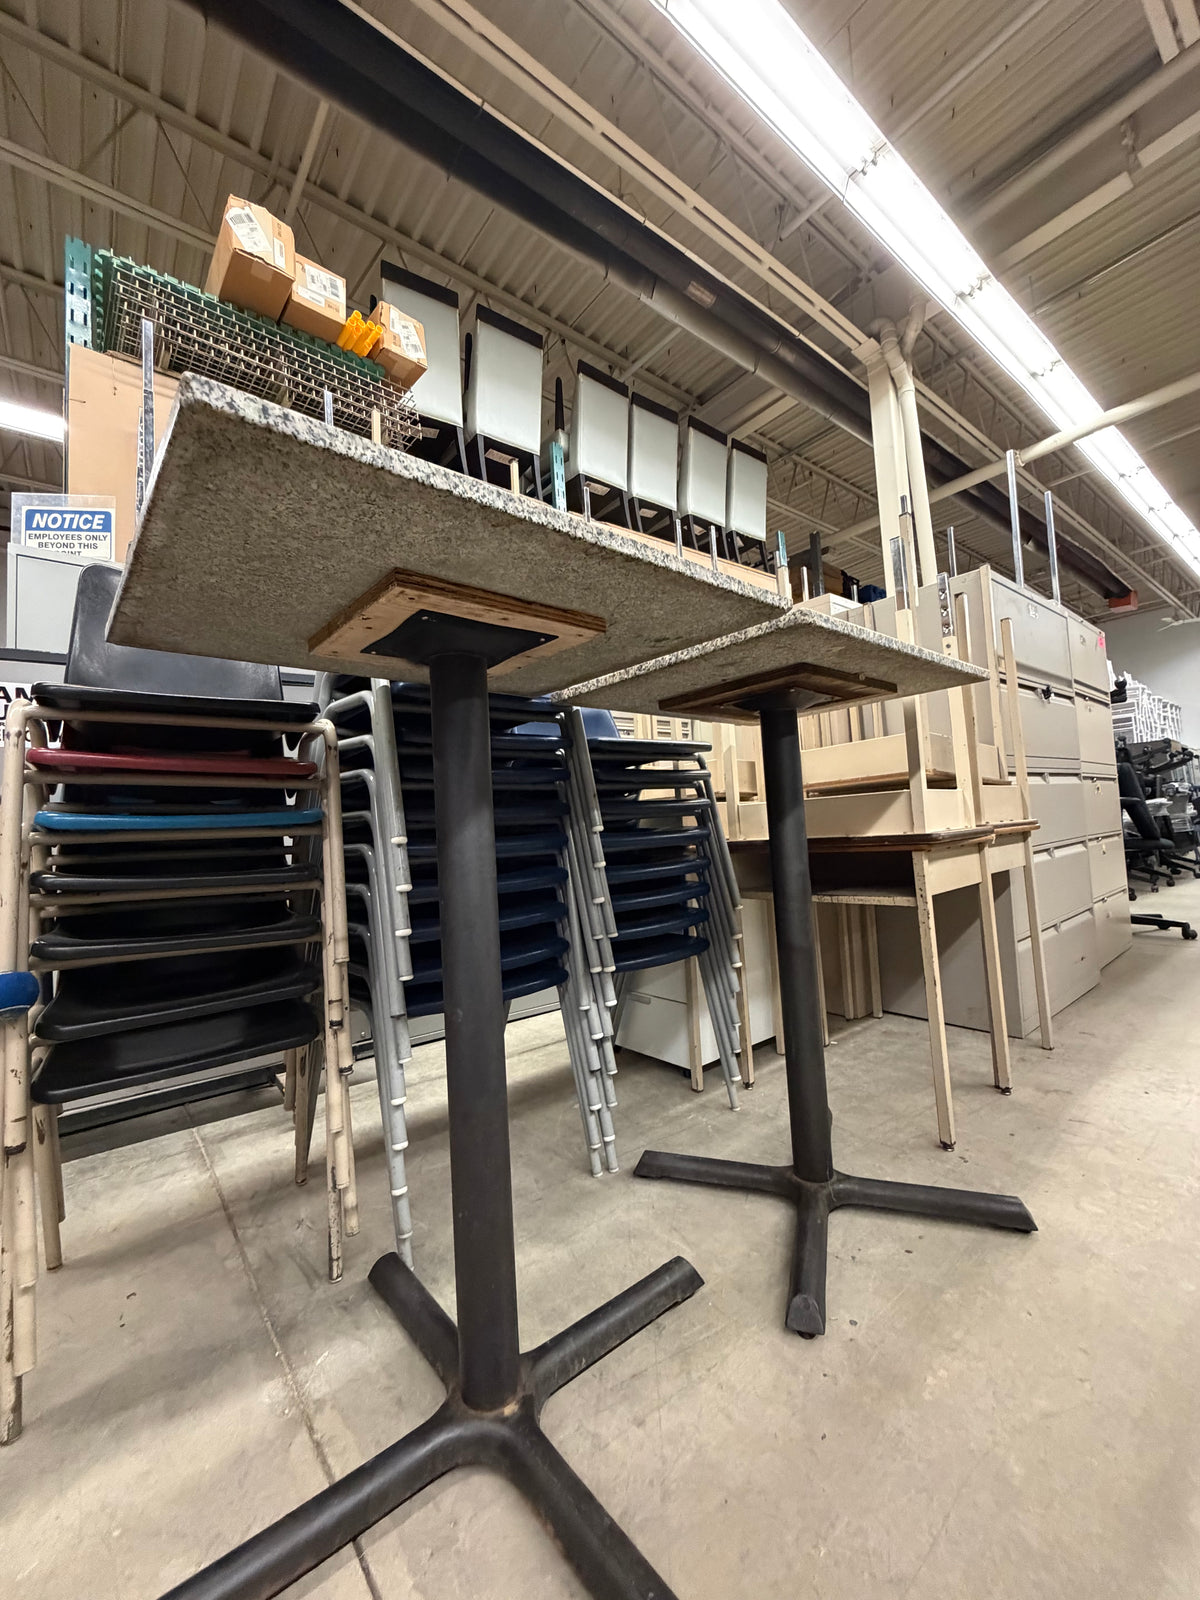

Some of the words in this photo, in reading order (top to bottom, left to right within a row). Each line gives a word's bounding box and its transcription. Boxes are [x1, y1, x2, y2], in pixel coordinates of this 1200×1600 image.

[32, 513, 105, 530] NOTICE
[28, 533, 82, 541] EMPLOYEES
[85, 534, 108, 542] ONLY
[38, 541, 75, 549] BEYOND
[78, 542, 98, 550] THIS
